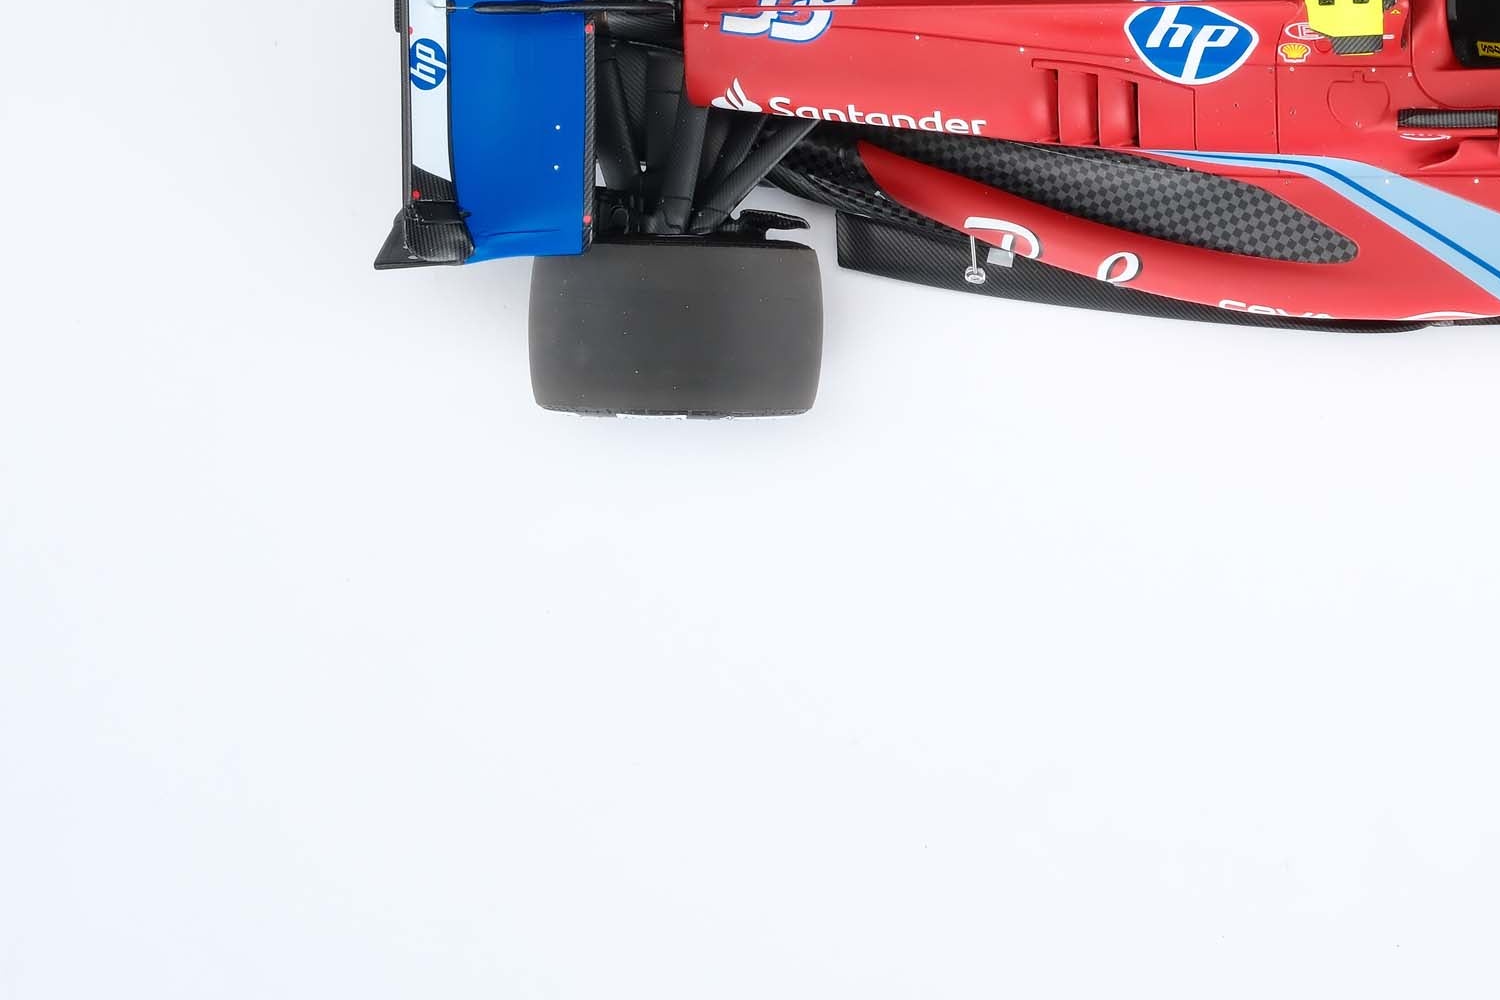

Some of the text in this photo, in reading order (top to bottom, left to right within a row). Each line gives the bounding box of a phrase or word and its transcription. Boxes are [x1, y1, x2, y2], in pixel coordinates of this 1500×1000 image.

[409, 42, 448, 85] hp
[1145, 6, 1240, 82] hp
[768, 96, 987, 136] Santander
